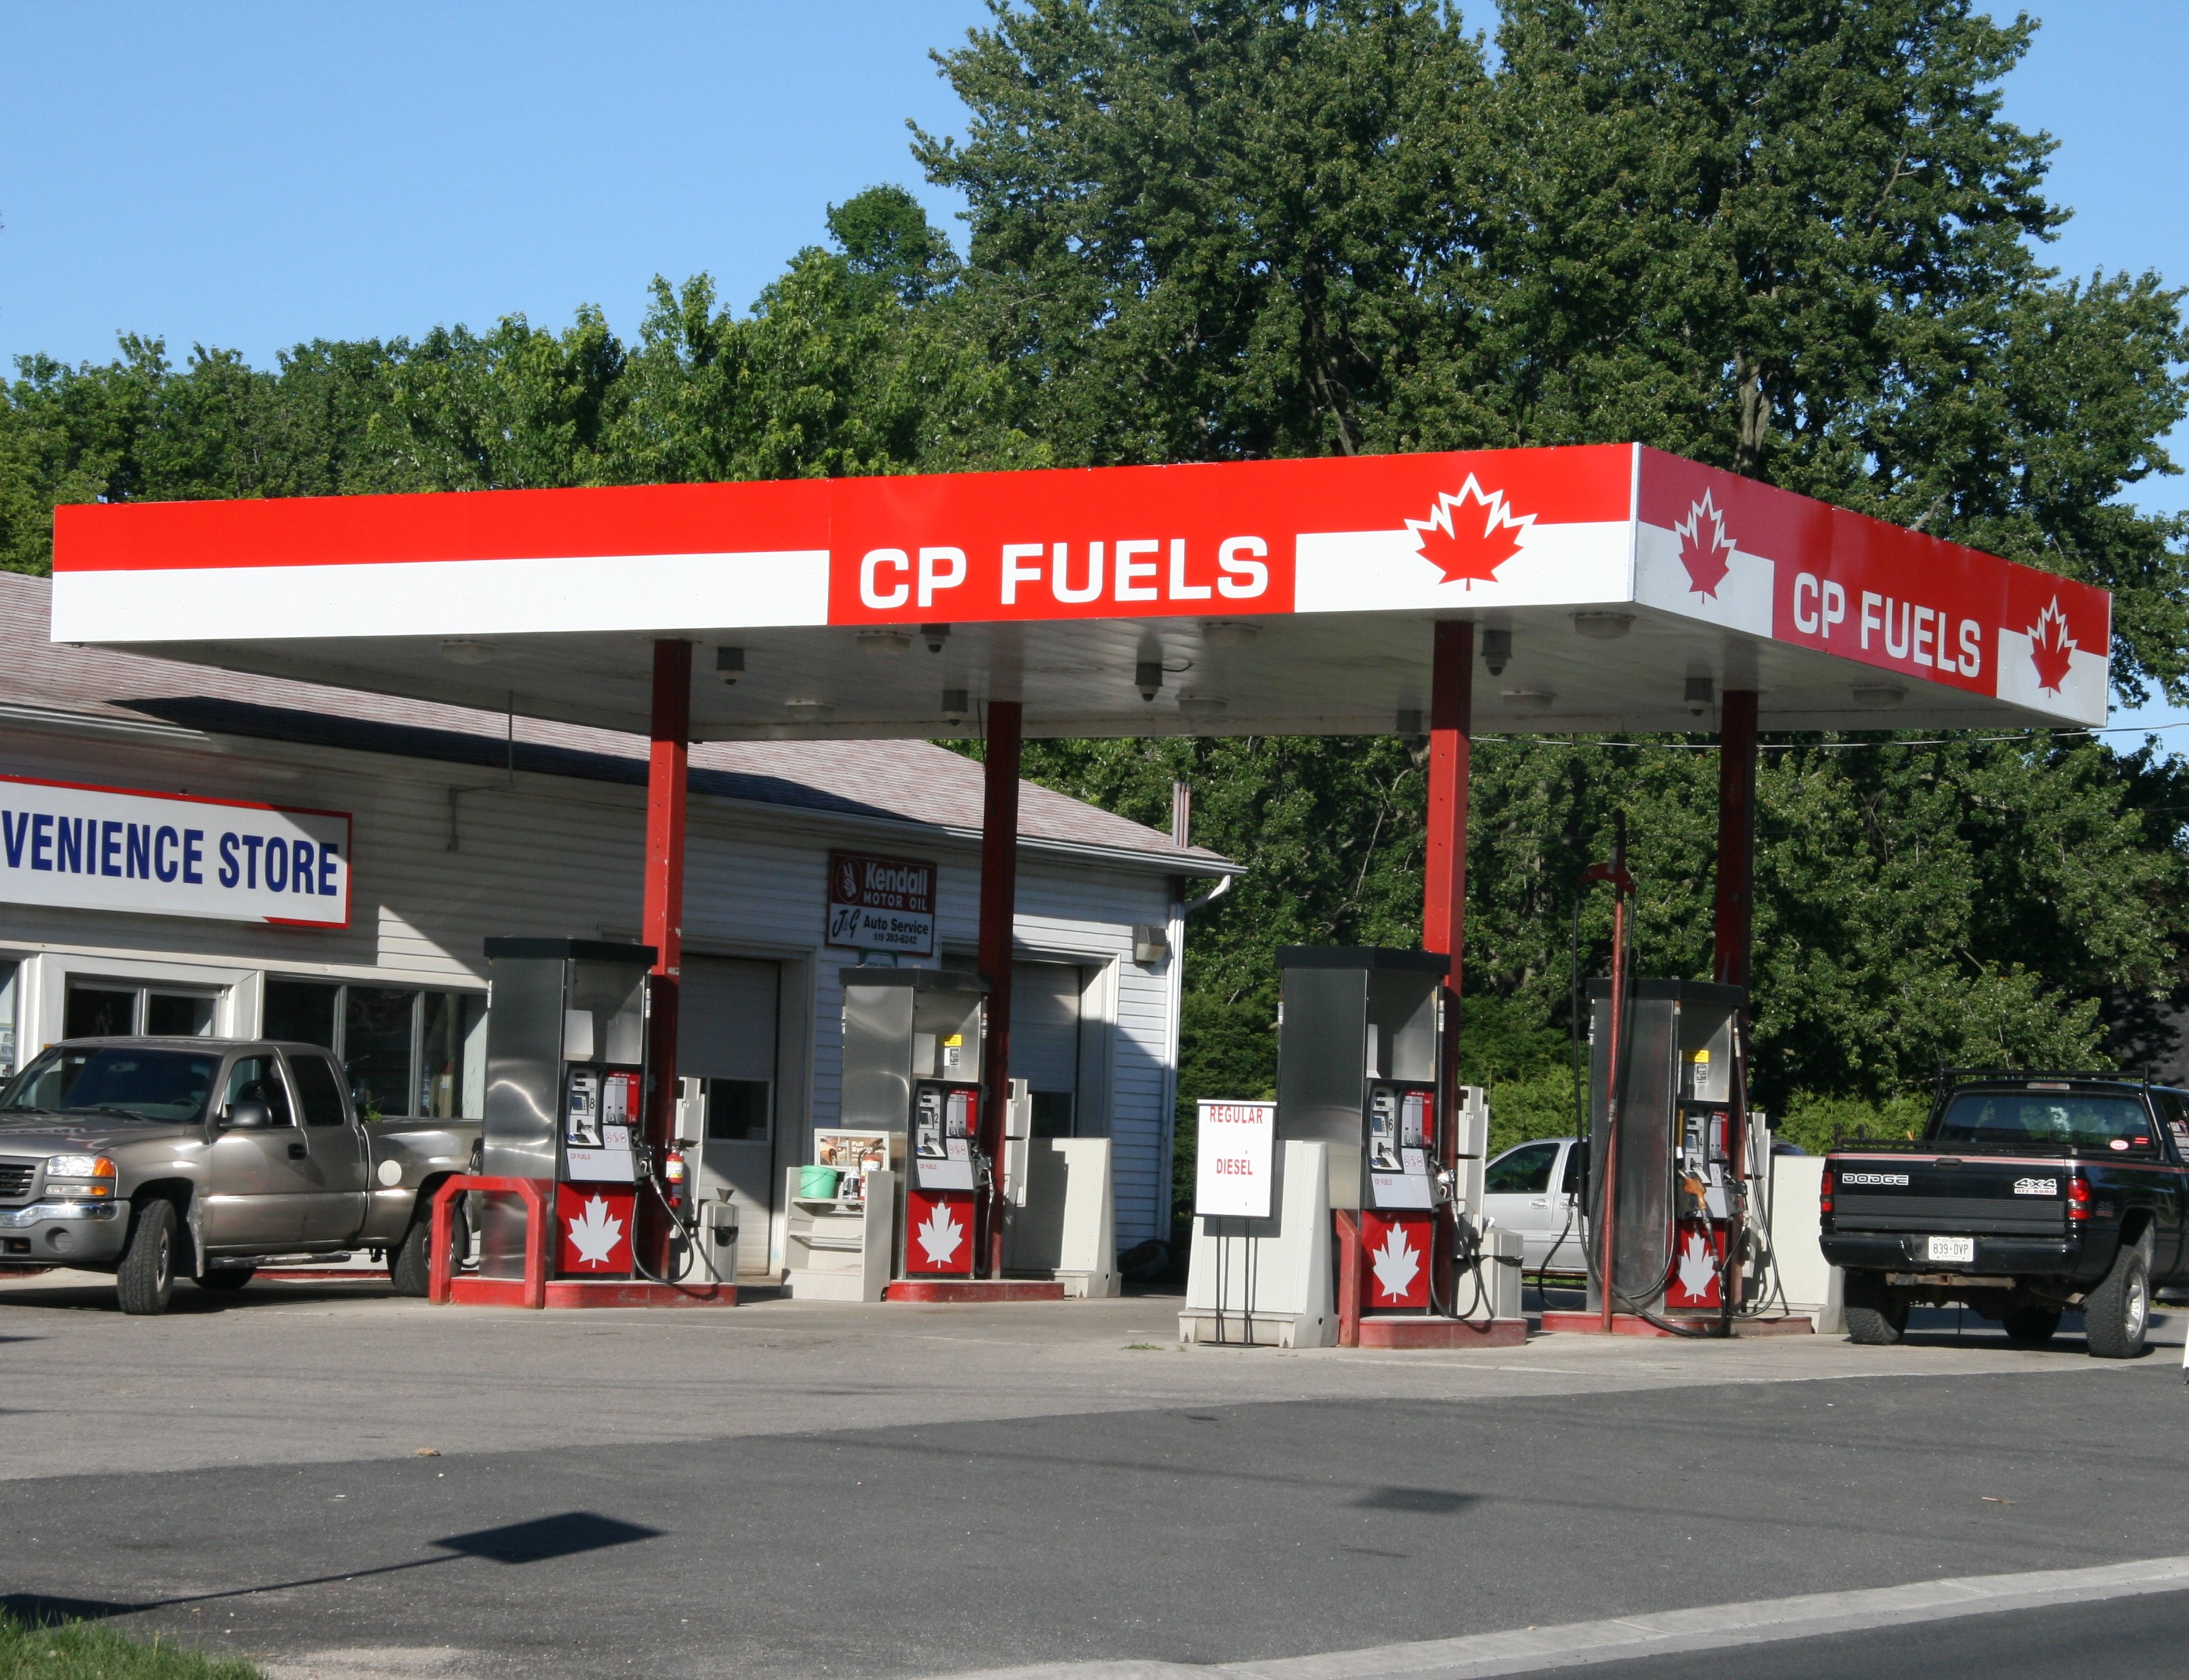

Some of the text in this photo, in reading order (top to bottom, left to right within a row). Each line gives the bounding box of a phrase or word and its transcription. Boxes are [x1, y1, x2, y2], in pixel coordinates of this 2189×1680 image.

[860, 536, 1269, 609] CP FUELS
[1793, 572, 1981, 678] CP FUELS
[1, 810, 338, 896] VENIENCE STORE
[865, 862, 928, 895] Kendall
[863, 891, 927, 911] MOTOR OIL
[863, 915, 888, 930] Auto
[891, 918, 929, 935] Service
[874, 933, 884, 941] 519
[589, 1097, 595, 1109] 8
[935, 1113, 939, 1124] 2
[1209, 1104, 1263, 1124] REGULAR
[1388, 1119, 1394, 1131] 6
[1216, 1158, 1253, 1176] DIESEL
[1842, 1172, 1909, 1186] DODGE
[1933, 1243, 1948, 1254] 839
